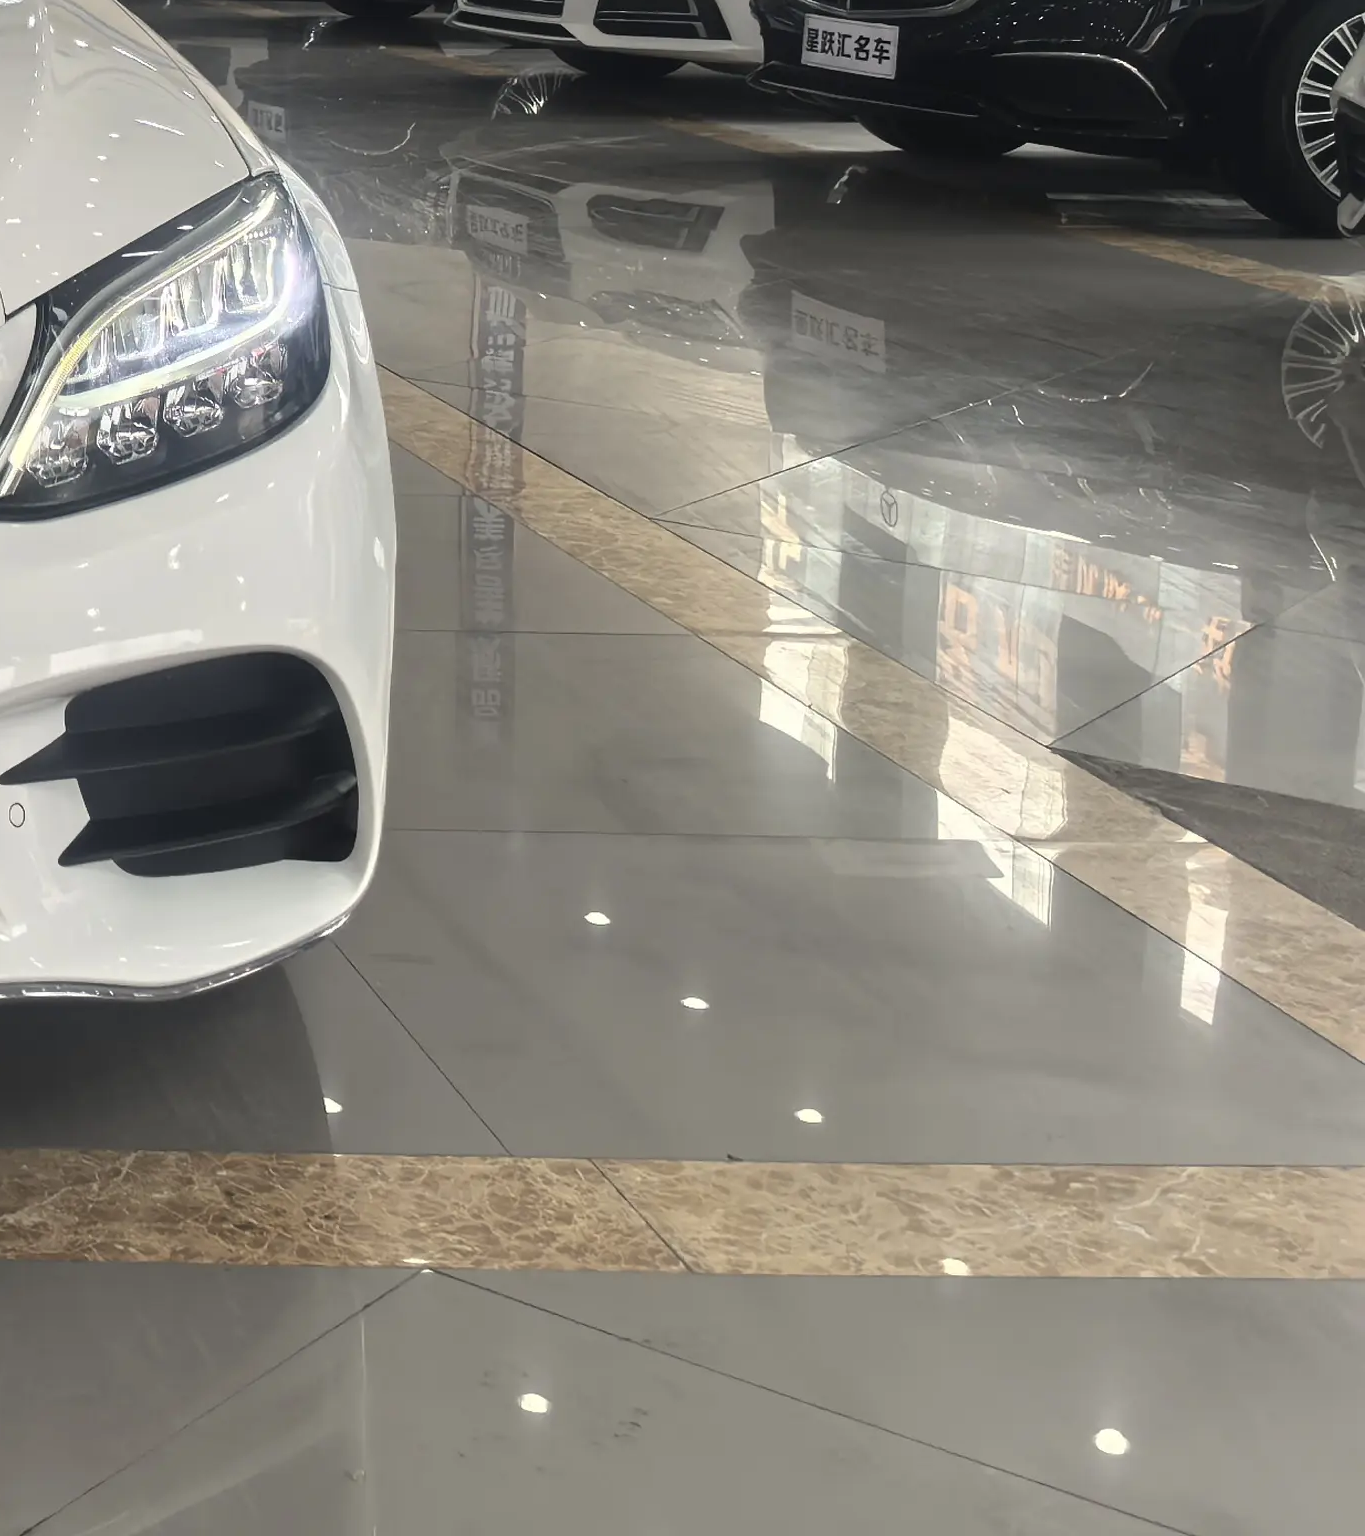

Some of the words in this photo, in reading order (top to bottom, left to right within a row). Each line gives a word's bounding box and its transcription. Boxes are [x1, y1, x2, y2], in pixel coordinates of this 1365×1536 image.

[805, 27, 892, 65] 星跃汇名车
